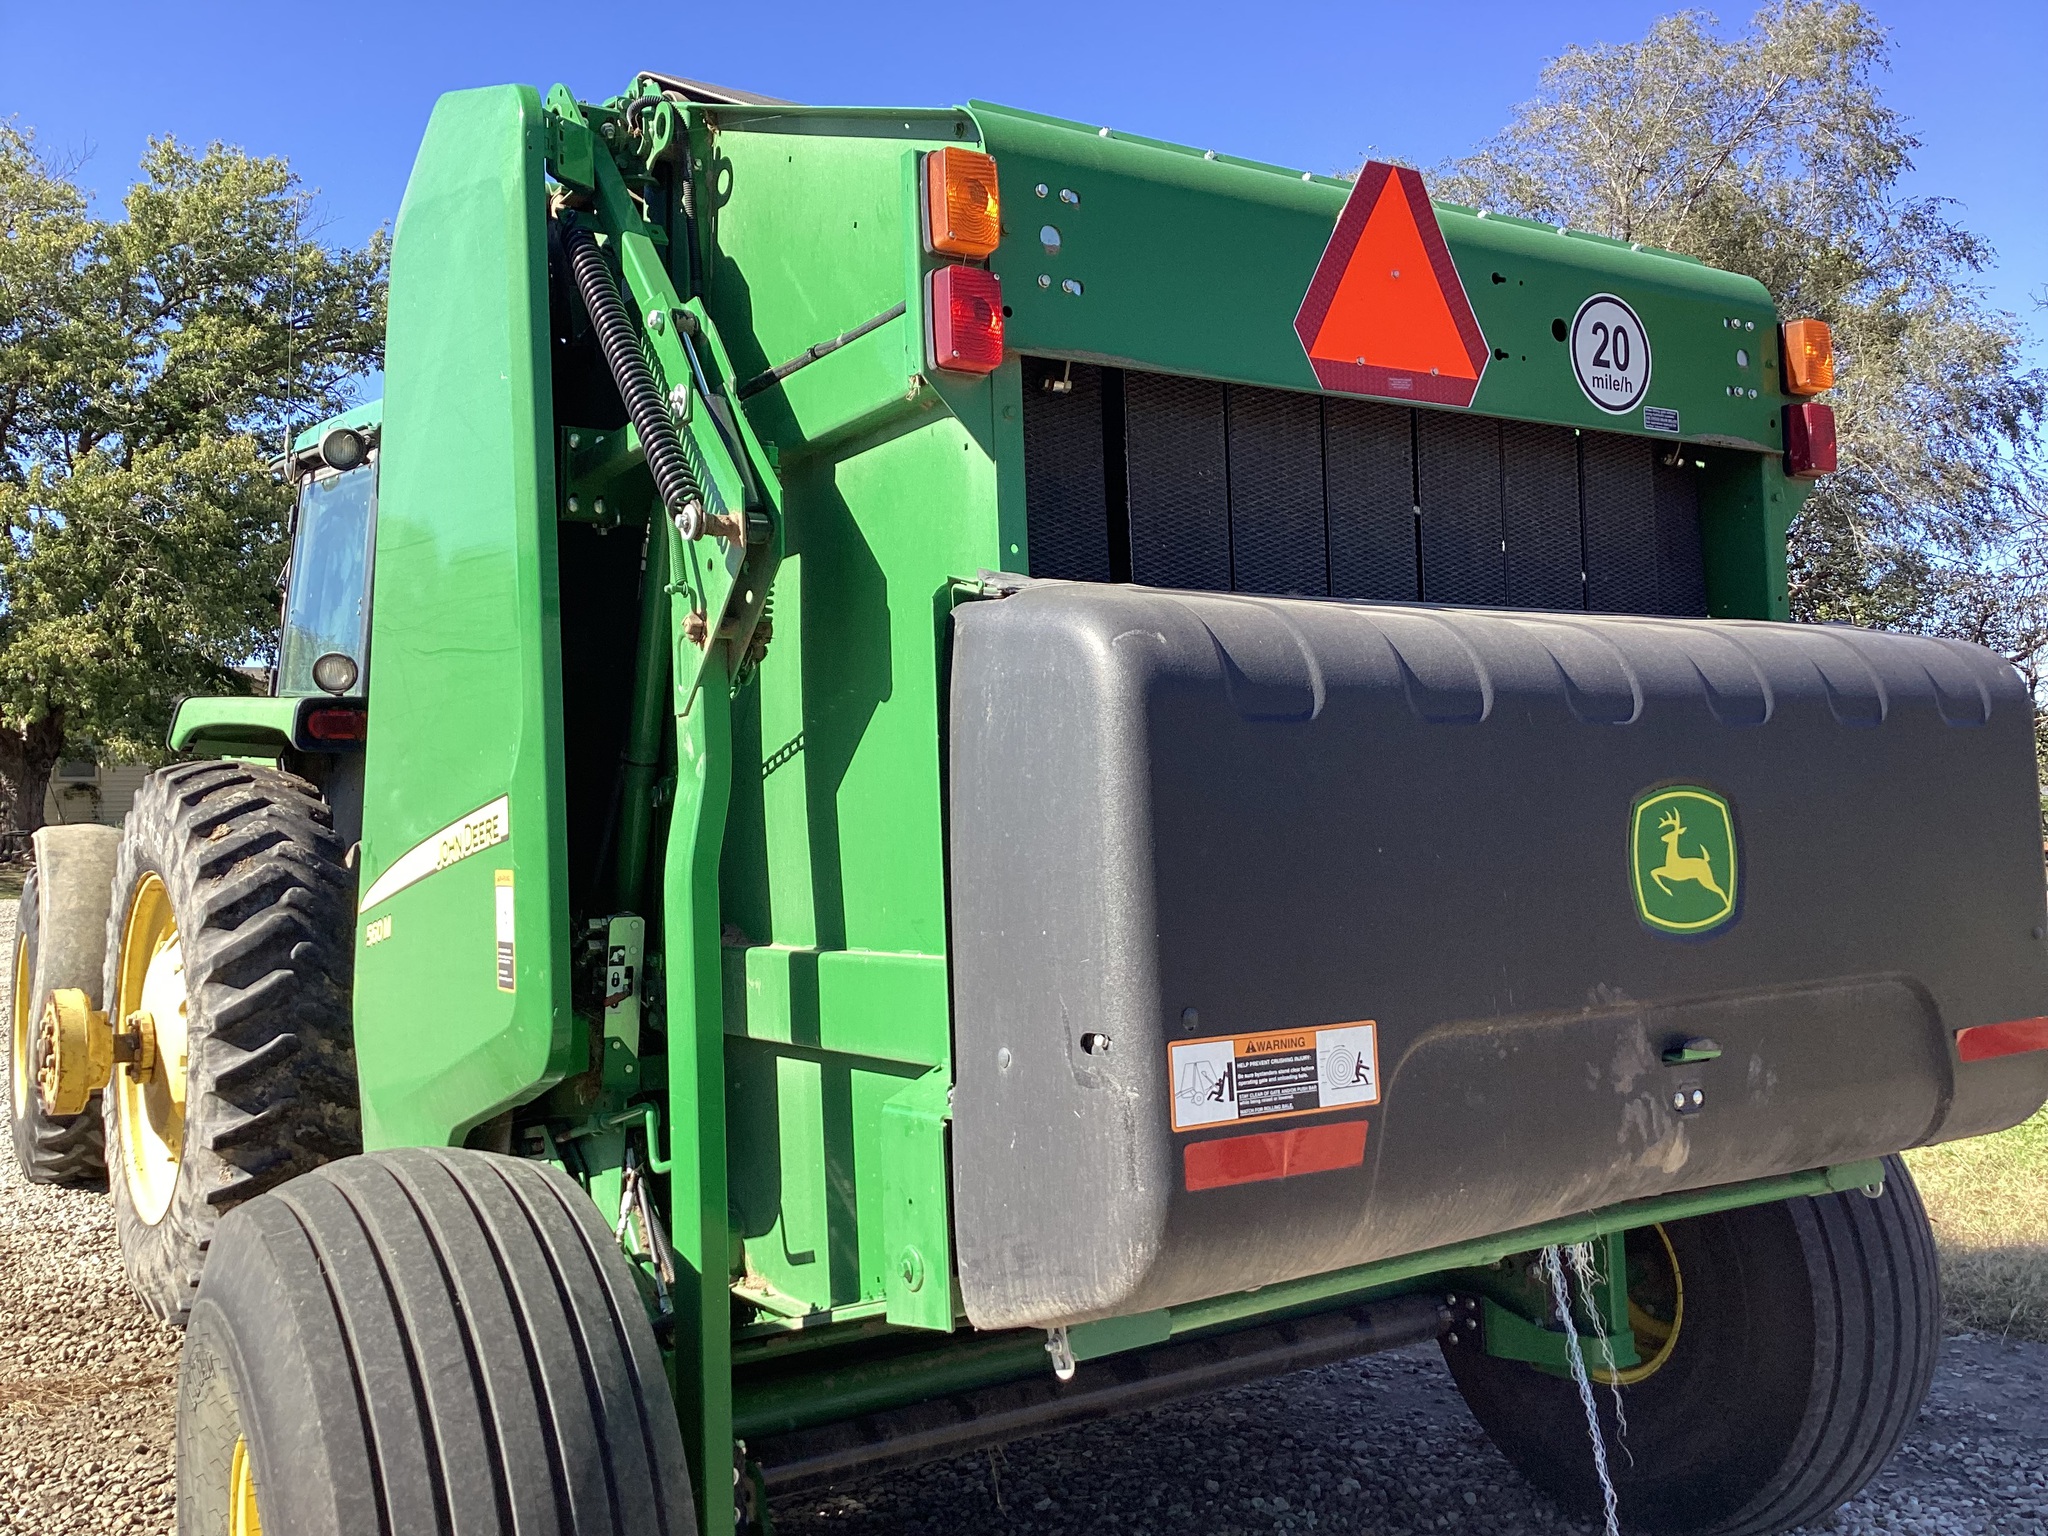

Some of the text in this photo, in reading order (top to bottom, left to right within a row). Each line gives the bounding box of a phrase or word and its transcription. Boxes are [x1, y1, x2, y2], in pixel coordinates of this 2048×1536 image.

[1592, 321, 1630, 372] 20
[1592, 373, 1633, 393] mile/h
[436, 814, 500, 870] JOHN DEERE
[1256, 1037, 1305, 1051] WARNING
[1250, 1059, 1270, 1067] PREVENT
[1271, 1057, 1293, 1065] CRUSHING
[1254, 1070, 1277, 1078] bystanders
